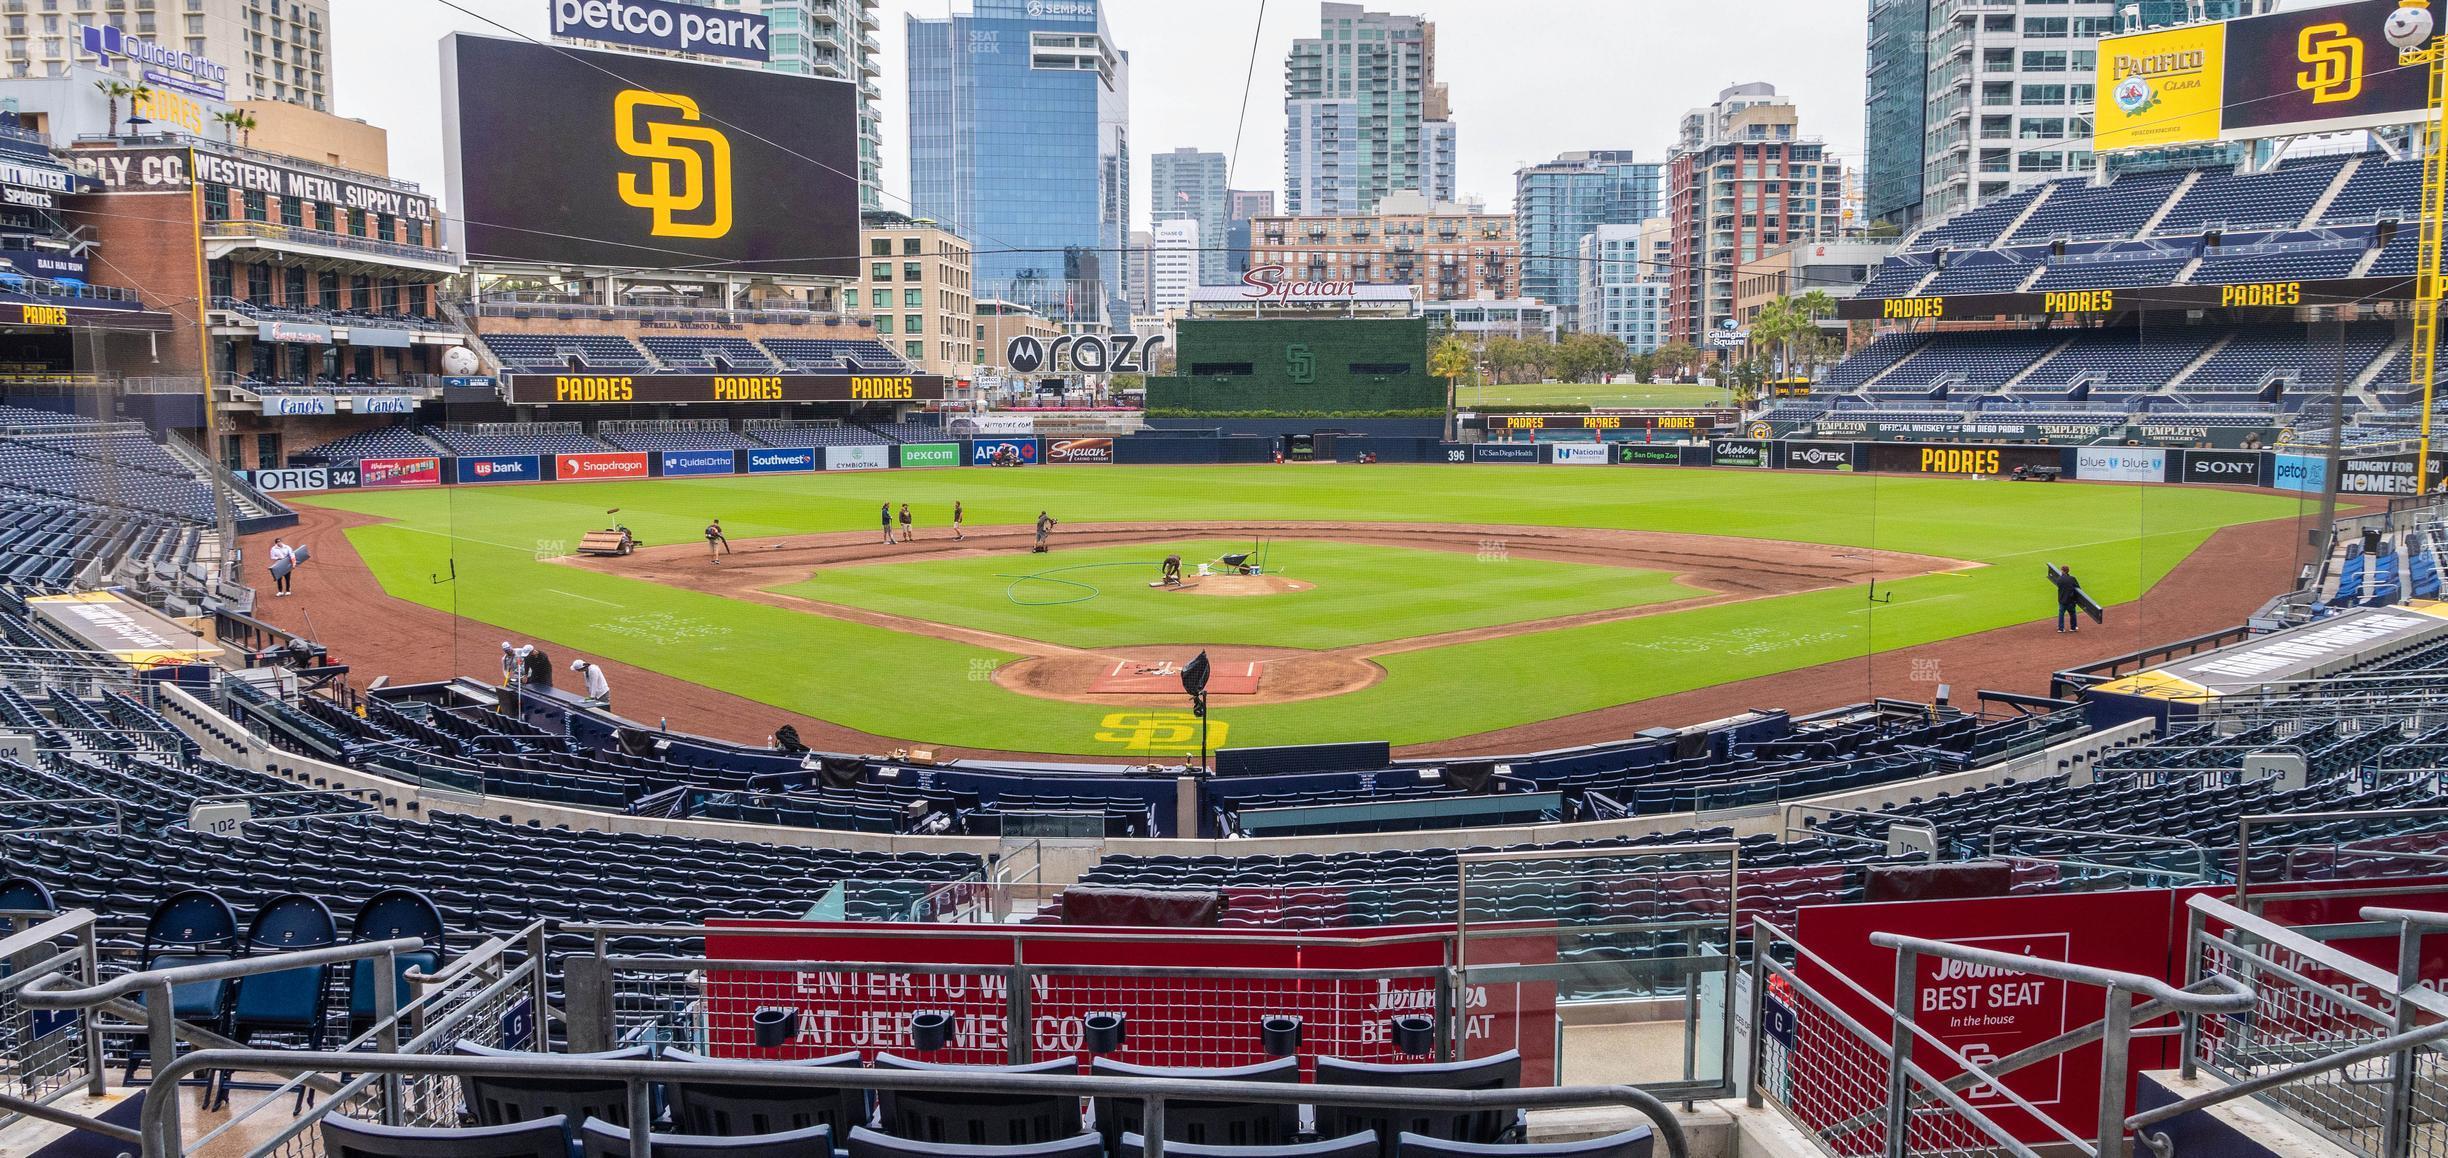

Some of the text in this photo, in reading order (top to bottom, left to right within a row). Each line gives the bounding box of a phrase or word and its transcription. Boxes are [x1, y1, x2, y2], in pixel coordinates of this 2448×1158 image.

[1046, 3, 1094, 15] SEMPRA
[556, 0, 767, 51] petco park
[124, 35, 226, 83] QuidelOrtho
[2296, 22, 2364, 104] SD
[134, 90, 203, 136] PADRES
[614, 89, 733, 239] SD
[193, 153, 431, 221] WESTERN METAL SUPPLY CO.
[3, 186, 52, 208] SPIRITS
[38, 259, 83, 272] BALI HAI RUM
[1241, 265, 1358, 307] Sycuan
[2045, 290, 2113, 313] PADRES
[2221, 282, 2300, 307] PADRES
[22, 305, 67, 325] PADRES
[1884, 297, 1944, 318] PADRES
[640, 321, 678, 329] ESTRELLA
[711, 323, 744, 331] LANDING
[1708, 330, 1751, 339] Gallagher
[1713, 338, 1744, 347] Square
[1049, 334, 1166, 373] razr
[556, 376, 633, 401] PADRES
[714, 376, 783, 400] PADRES
[851, 376, 913, 399] PADRES
[280, 398, 324, 415] Canel's
[367, 397, 404, 413] Canel's
[1507, 417, 1544, 428] PADRES
[1583, 417, 1620, 428] PADRES
[1658, 417, 1695, 428] PADRES
[1816, 423, 1867, 431] TEMPLETON
[1879, 424, 1910, 432] OFFICIAL
[1912, 424, 1945, 432] WHISKEY
[1962, 425, 1976, 433] SAN
[1977, 425, 1997, 433] DIEGO
[1998, 425, 2025, 434] PADRES
[2037, 425, 2099, 436] TEMPLETON
[2140, 426, 2208, 437] TEMPLETON
[1051, 441, 1107, 462] Sycuan
[1448, 450, 1465, 461] 396
[1499, 450, 1515, 458] Diego
[1572, 448, 1604, 456] National
[1634, 451, 1678, 460] San Diego Zoo
[1716, 441, 1757, 455] Chosen
[1792, 448, 1845, 464] EVOTEK
[477, 461, 523, 474] us bank
[583, 460, 642, 473] Snapdragon
[679, 457, 731, 468] QuidelOrtho
[752, 453, 804, 467] Southwest
[1921, 448, 2000, 474] PADRES
[2080, 456, 2149, 469] blue blue
[2195, 461, 2255, 474] SONY
[2347, 461, 2413, 473] HUNGRY FOR
[333, 471, 356, 486] 342
[2277, 463, 2308, 480] petco
[259, 470, 325, 490] ORIS
[2341, 474, 2418, 493] HOMERS
[210, 818, 236, 834] 102
[797, 962, 1048, 1000] ENTER TO WN
[1922, 982, 2045, 1012] BEST SEAT
[514, 1015, 522, 1035] G
[1775, 1012, 1783, 1032] G
[1950, 1014, 2015, 1027] In the house
[796, 1010, 834, 1044] AT
[851, 1010, 1010, 1049] JERMES
